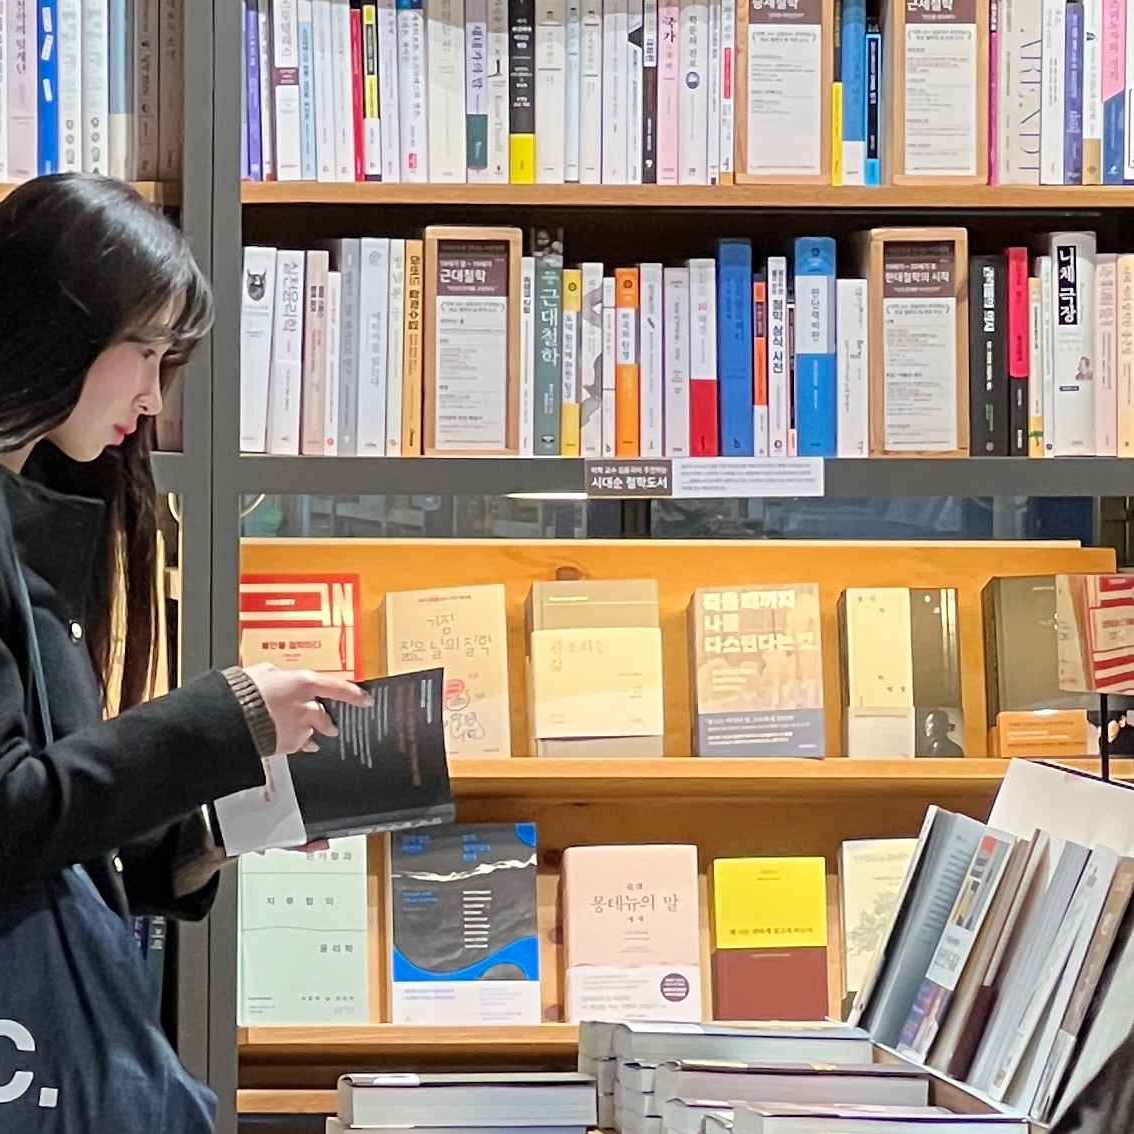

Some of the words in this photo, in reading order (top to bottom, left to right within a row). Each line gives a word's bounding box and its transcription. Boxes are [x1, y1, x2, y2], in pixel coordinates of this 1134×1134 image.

[409, 255, 420, 286] 하버드
[440, 269, 486, 283] 근대철학
[885, 272, 930, 283] 현대철학의
[932, 271, 950, 282] 시작
[1059, 247, 1074, 284] 니체
[282, 260, 299, 333] 실천윤리학
[1058, 287, 1076, 324] 극장
[540, 288, 560, 367] 근대철학
[591, 476, 623, 490] 시대순
[626, 476, 668, 491] 철학도서
[703, 590, 739, 611] 죽을
[740, 588, 796, 610] 때까지
[426, 613, 456, 636] 가장
[703, 613, 739, 632] 나를
[399, 641, 426, 663] 젊은
[430, 637, 460, 661] 날의
[464, 636, 493, 659] 철학
[704, 632, 794, 654] 다스린다는
[796, 631, 814, 651] 것
[590, 893, 655, 914] 몽테뉴의
[663, 893, 679, 912] 말
